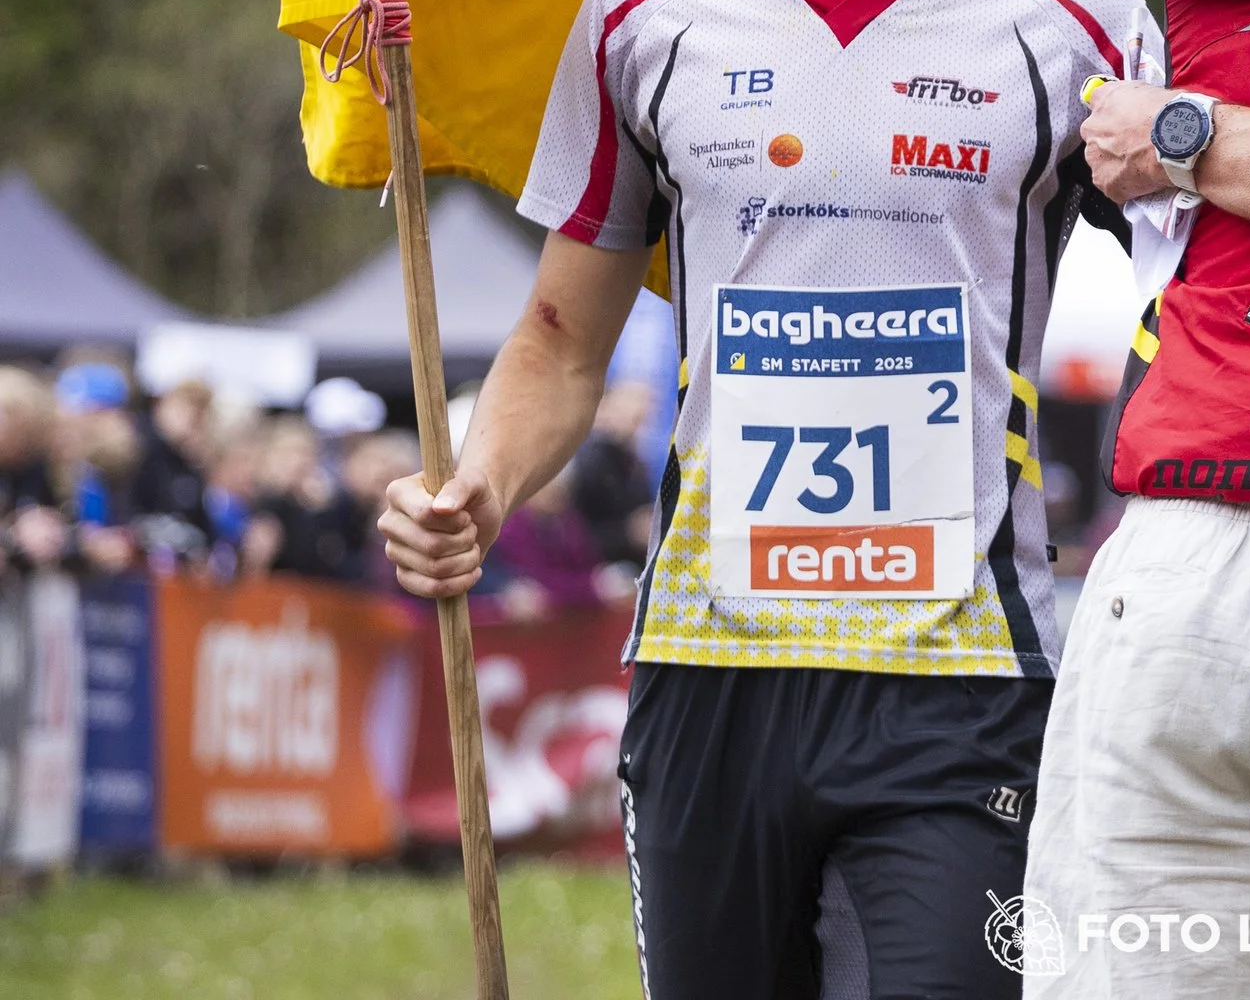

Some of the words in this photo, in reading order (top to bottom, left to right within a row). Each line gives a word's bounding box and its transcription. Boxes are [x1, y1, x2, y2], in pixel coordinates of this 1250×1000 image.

[723, 69, 775, 95] TB
[907, 76, 984, 105] fri-bo
[720, 100, 772, 110] GRUPPEN
[689, 138, 756, 158] Sparbanken
[891, 134, 991, 174] MAXI
[706, 154, 756, 170] Alingsås
[890, 166, 907, 176] ICA
[909, 167, 987, 184] STORMARKNAD
[722, 302, 958, 345] bagheera
[761, 357, 783, 371] SM
[791, 358, 861, 372] STAFETT
[875, 356, 913, 371] 2025
[926, 379, 960, 424] 2
[741, 424, 891, 514] 731
[768, 538, 917, 582] renta
